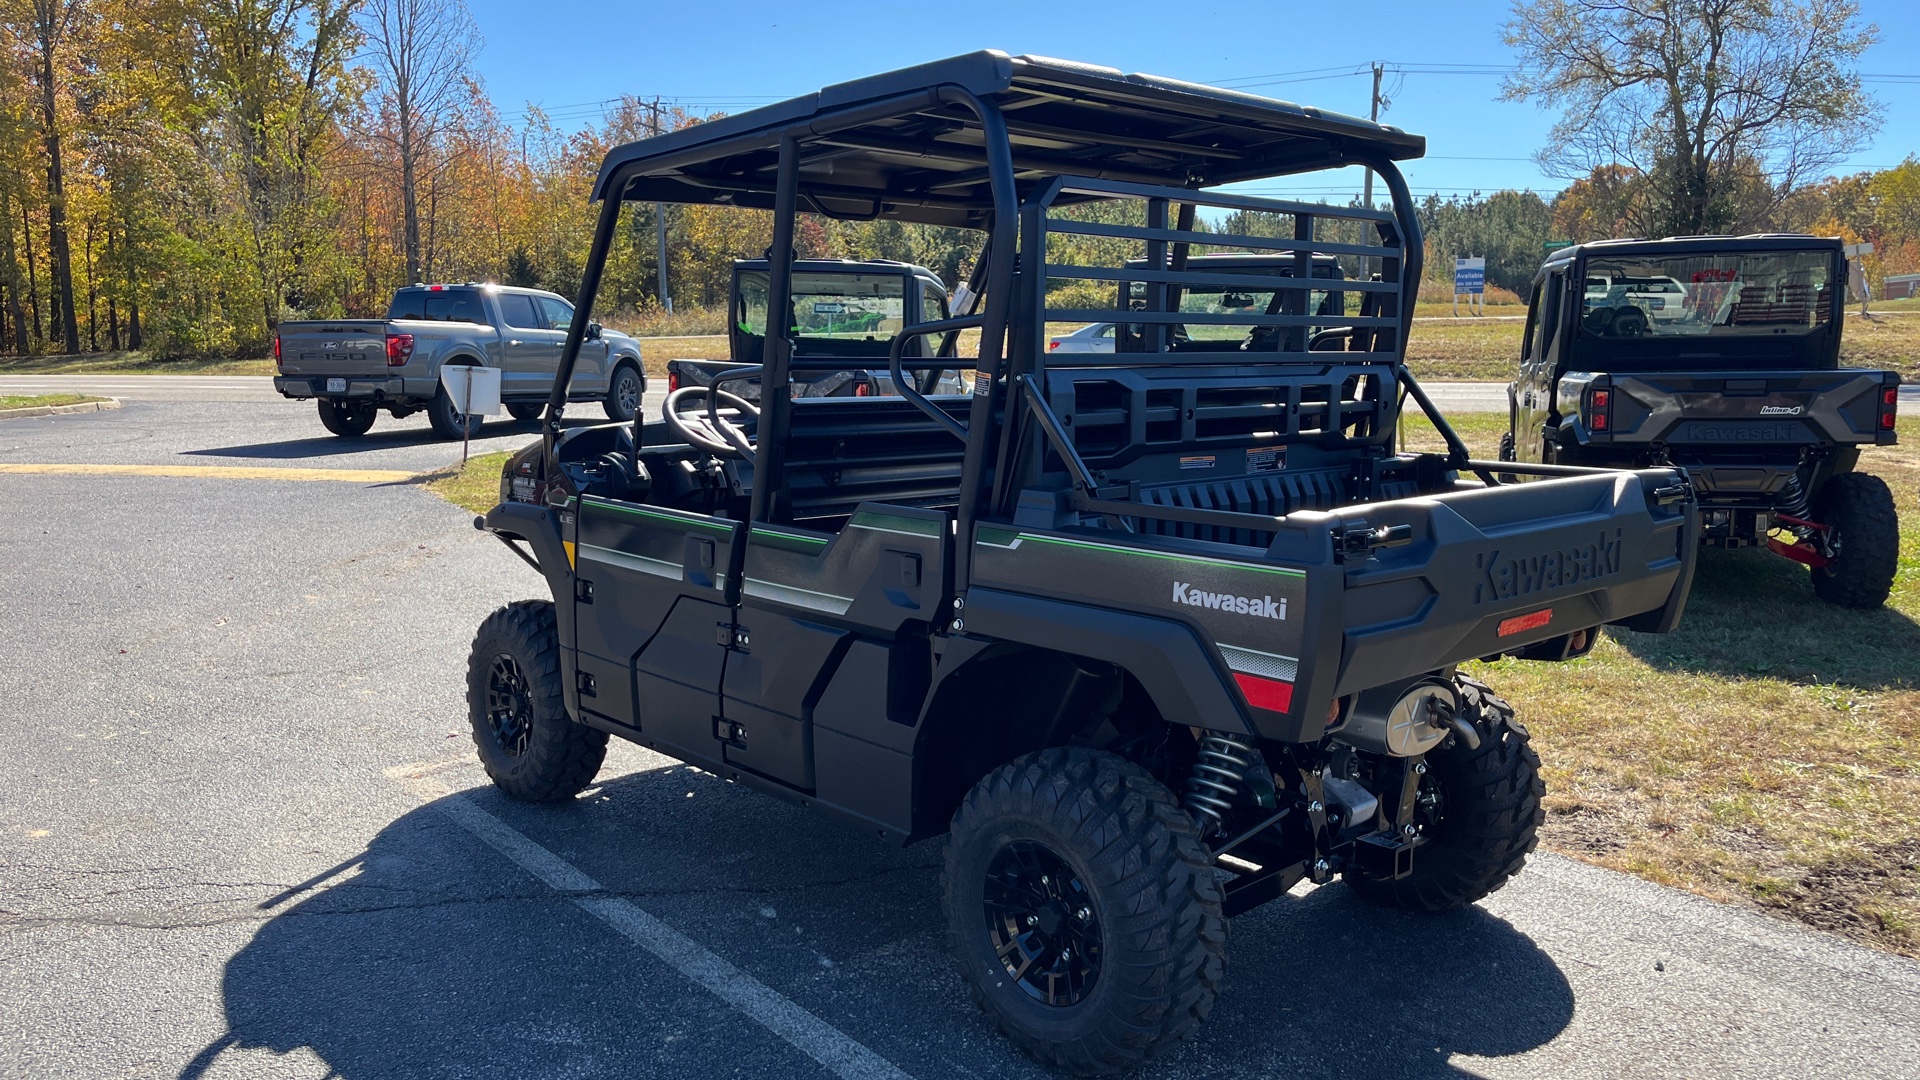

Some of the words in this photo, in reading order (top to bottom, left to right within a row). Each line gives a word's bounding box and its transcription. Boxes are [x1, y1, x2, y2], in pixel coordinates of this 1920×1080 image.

[299, 352, 367, 361] F-150
[1688, 424, 1796, 440] Kawasaki
[560, 514, 574, 524] LE
[1473, 528, 1622, 605] Kawasaki
[1172, 581, 1288, 620] Kawasaki
